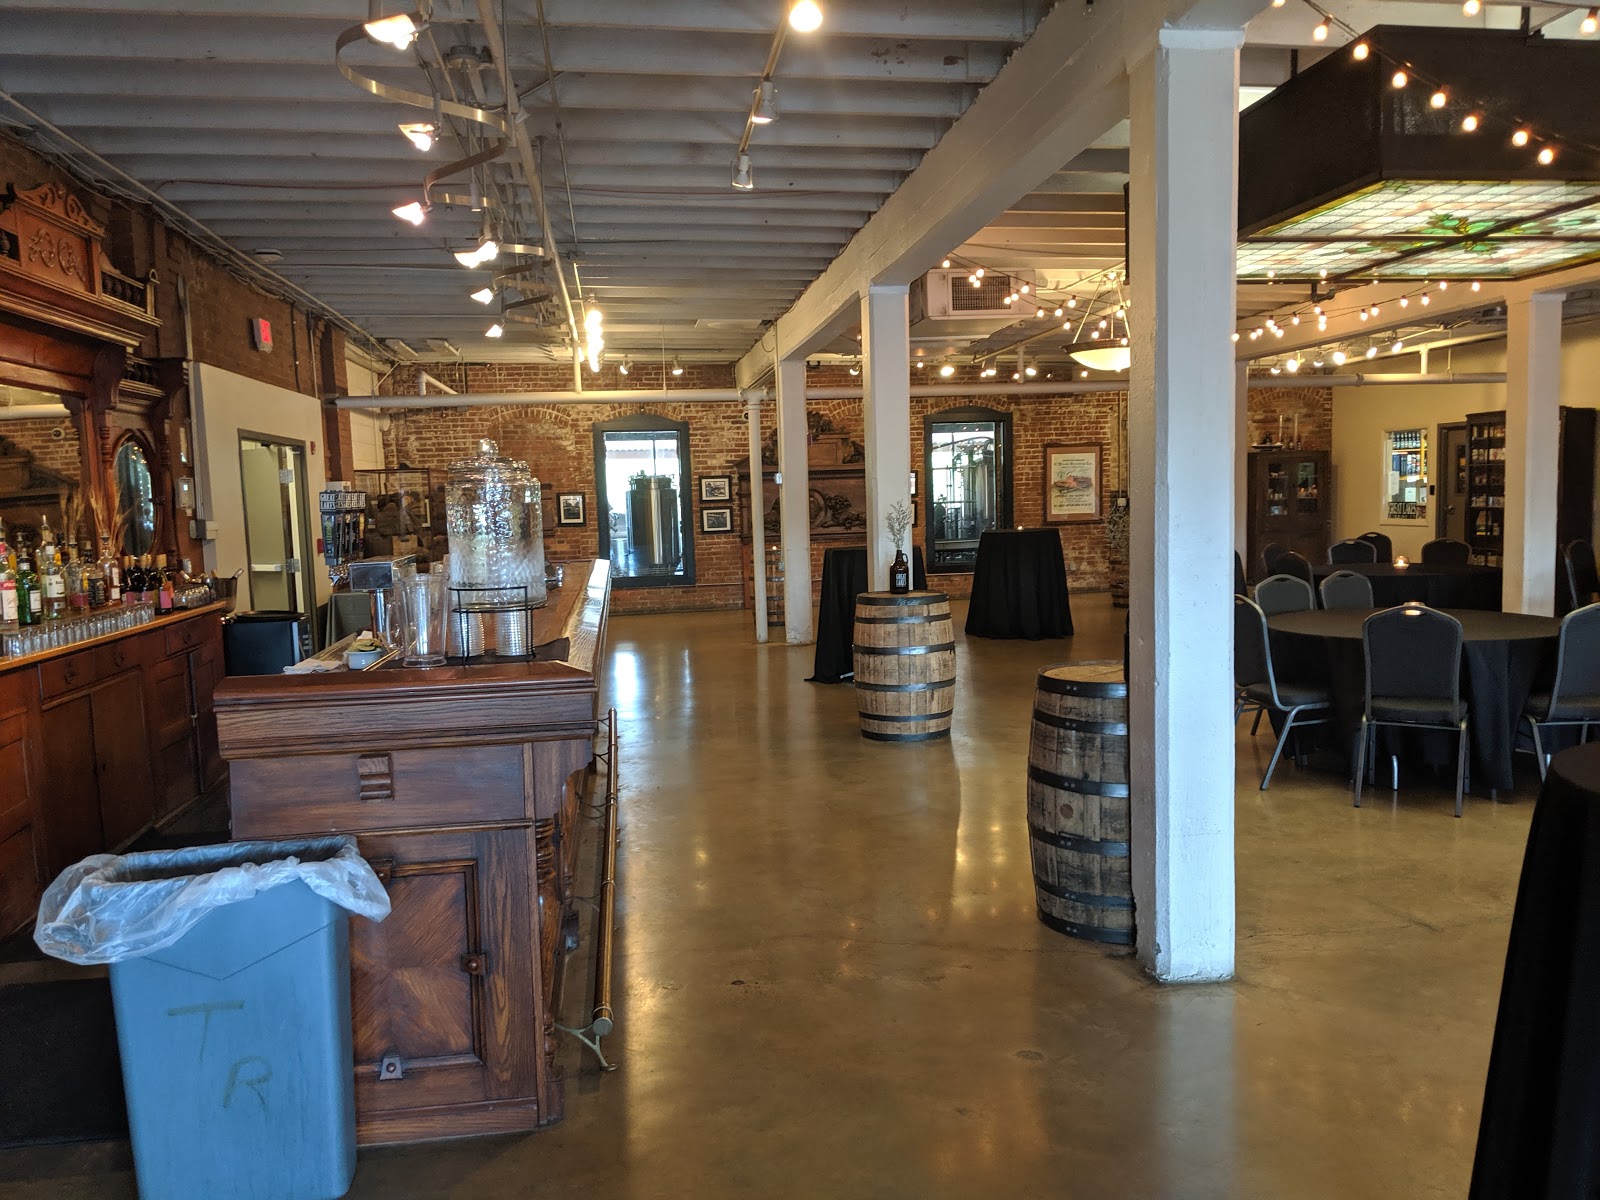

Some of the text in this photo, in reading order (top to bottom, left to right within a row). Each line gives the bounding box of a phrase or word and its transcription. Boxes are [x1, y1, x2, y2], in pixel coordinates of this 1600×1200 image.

[320, 493, 336, 501] GREAT
[320, 501, 336, 509] LAKES
[166, 999, 246, 1063] T
[222, 1055, 274, 1117] R
